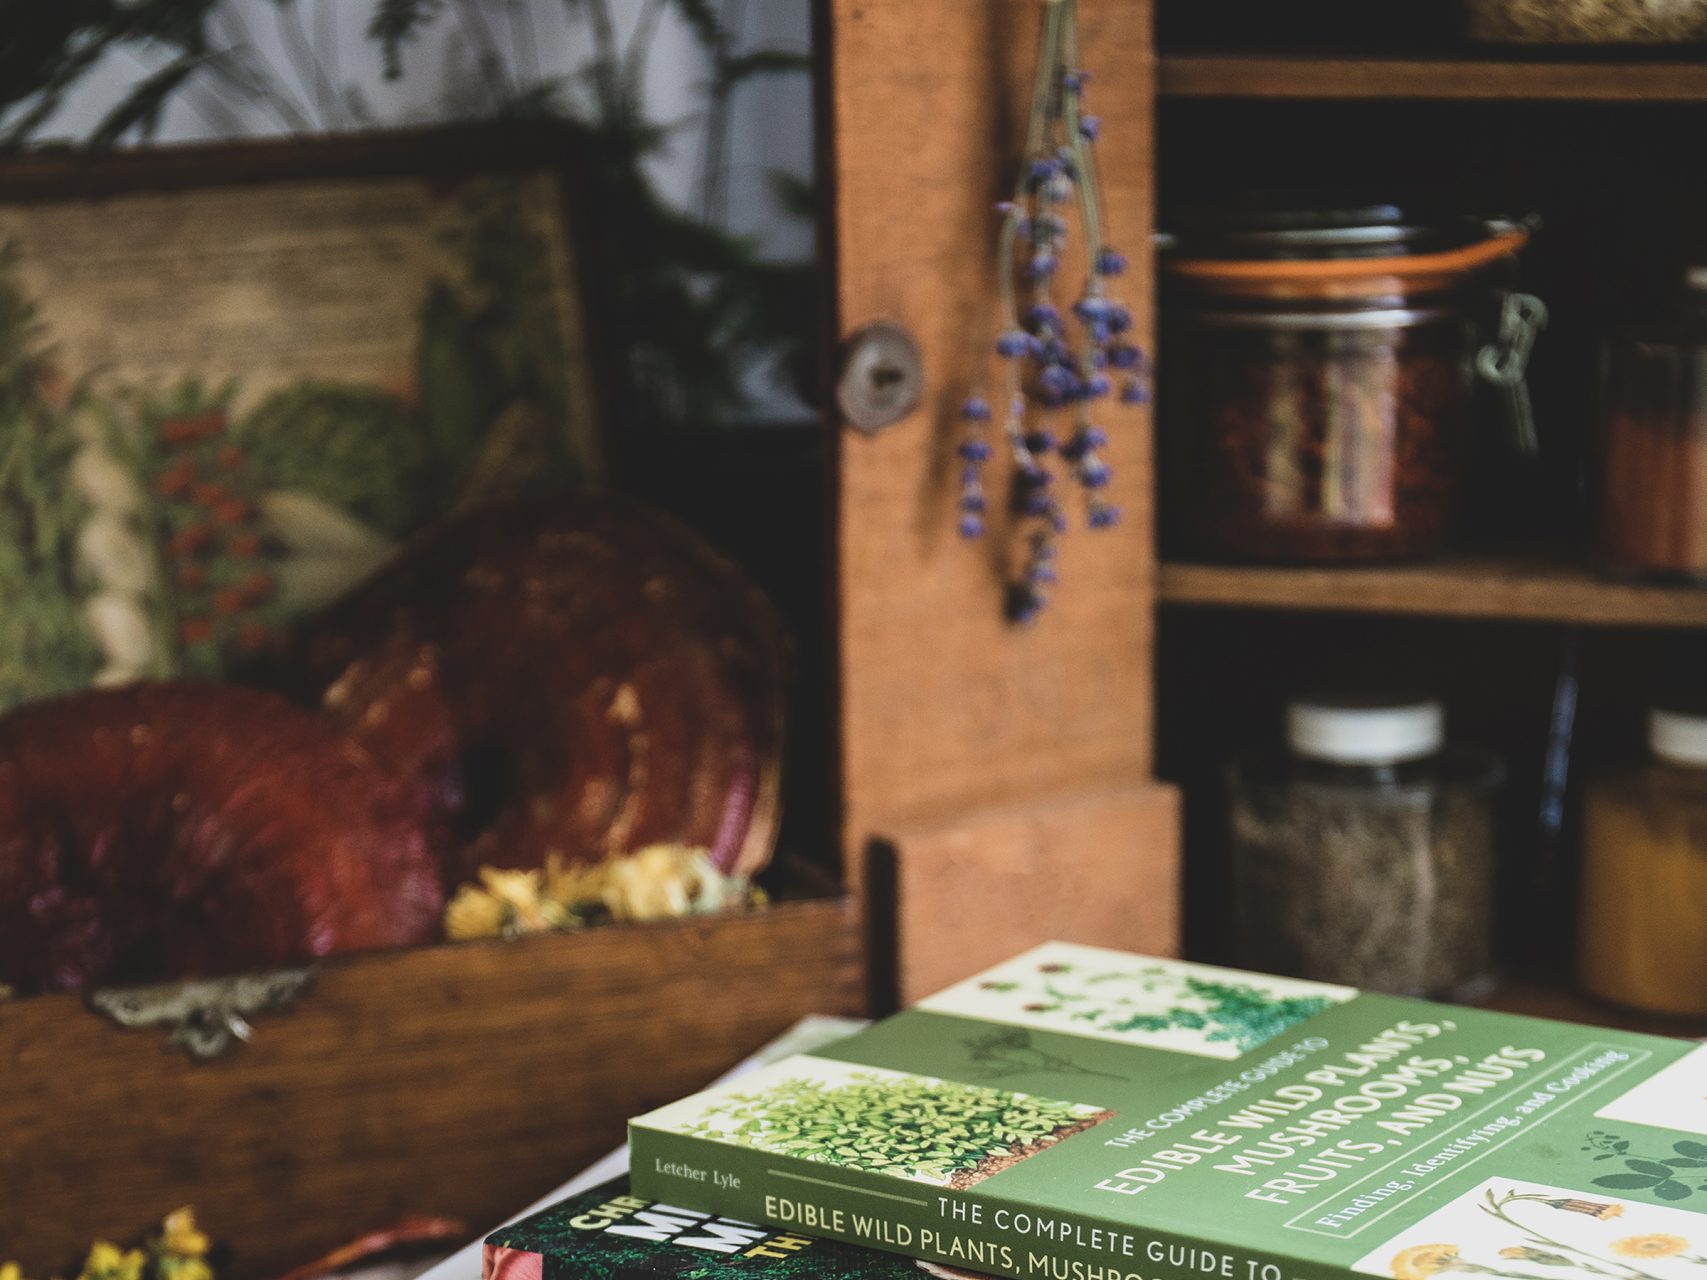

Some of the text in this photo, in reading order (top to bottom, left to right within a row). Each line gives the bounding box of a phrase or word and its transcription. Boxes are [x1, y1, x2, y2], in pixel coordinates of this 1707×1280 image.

[1094, 1019, 1457, 1195] EDIBLE WILD PLANTS,
[1104, 1036, 1329, 1148] THE COMPLETE GUIDE TO
[1212, 1054, 1469, 1176] MUSHROOMS,
[1244, 1045, 1546, 1204] FRUITS, AND NUTS
[1315, 1050, 1630, 1229] Finding, Identifying, and Cooking
[655, 1158, 741, 1189] Letcher Lyle
[765, 1196, 845, 1233] EDIBLE
[852, 1214, 913, 1247] WILD
[920, 1229, 1021, 1275] PLANTS,
[938, 1197, 983, 1224] THE
[994, 1210, 1135, 1257] COMPLETE
[1147, 1241, 1234, 1277] GUIDE
